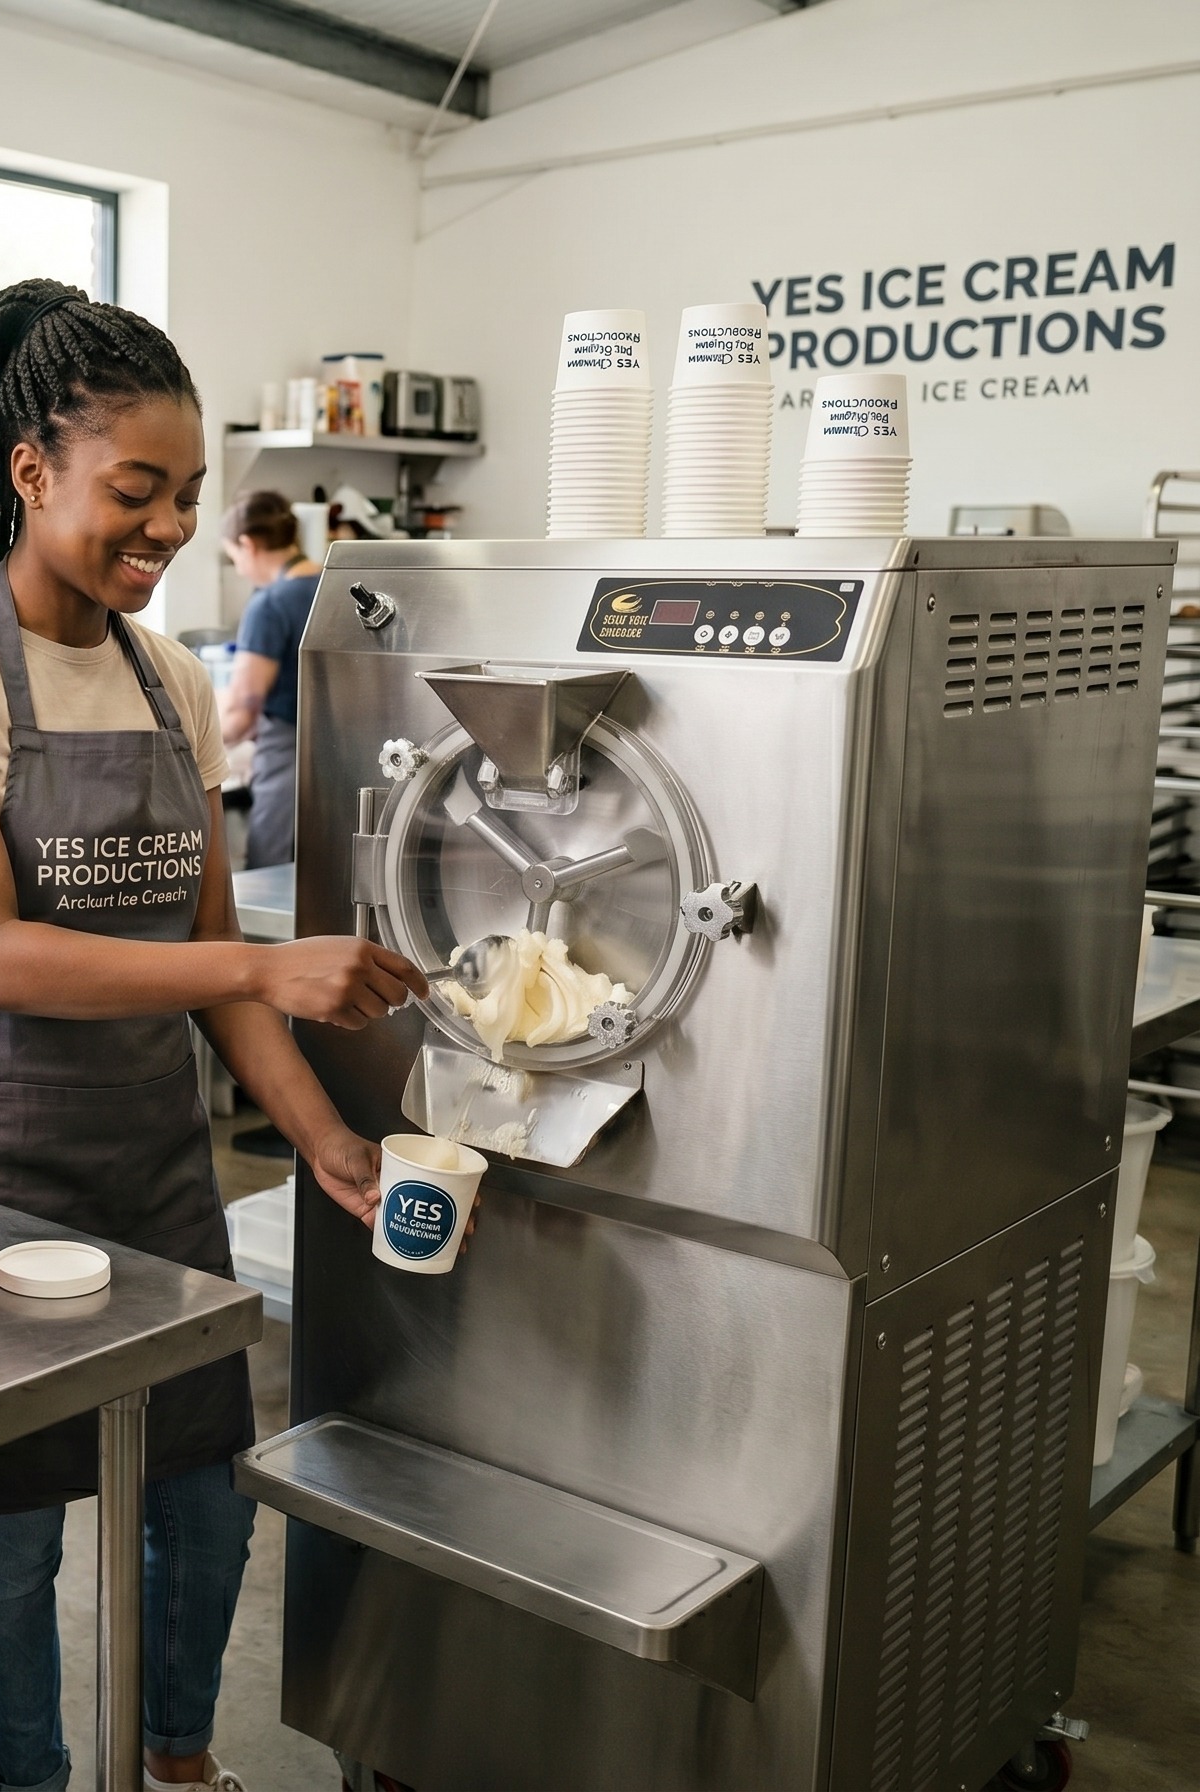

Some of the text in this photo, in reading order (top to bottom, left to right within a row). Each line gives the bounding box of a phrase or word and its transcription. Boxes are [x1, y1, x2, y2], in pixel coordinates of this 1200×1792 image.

[752, 242, 1176, 316] YES ICE CREAM
[768, 305, 1166, 370] PRODUCTIONS
[922, 374, 1090, 402] ICE CREAM
[35, 829, 203, 859] YES ICE CREAM
[37, 855, 201, 886] PRODUCTIONS
[118, 891, 138, 906] Ice
[398, 1194, 443, 1221] YES
